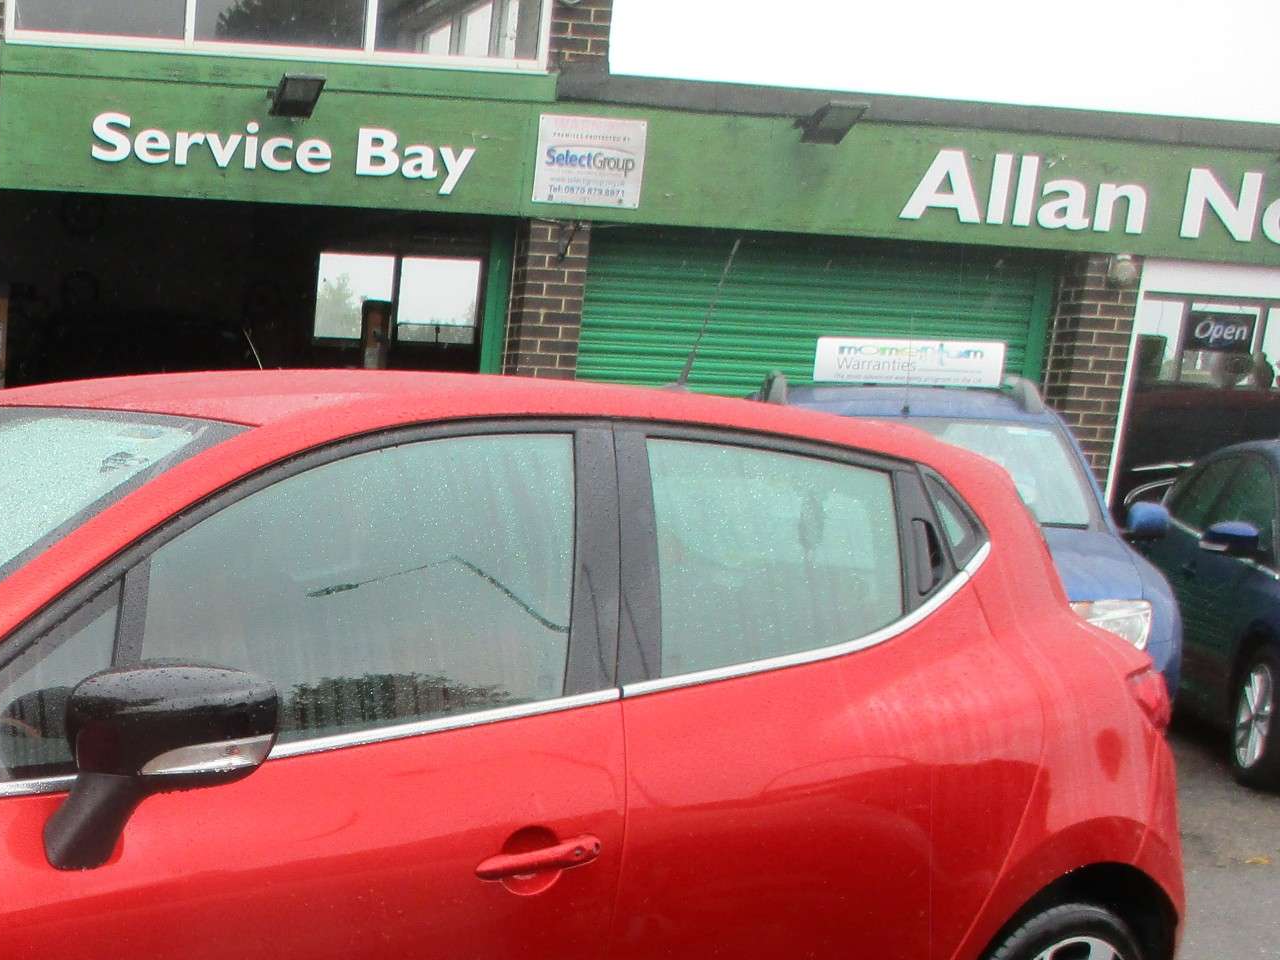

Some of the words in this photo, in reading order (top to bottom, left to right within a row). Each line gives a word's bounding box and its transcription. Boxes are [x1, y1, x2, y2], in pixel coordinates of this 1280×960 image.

[91, 111, 332, 174] Service
[355, 125, 477, 195] Bay
[545, 145, 636, 177] SelectGroup
[898, 149, 1148, 235] Allan
[1194, 319, 1248, 344] Open
[836, 357, 918, 371] Warranties
